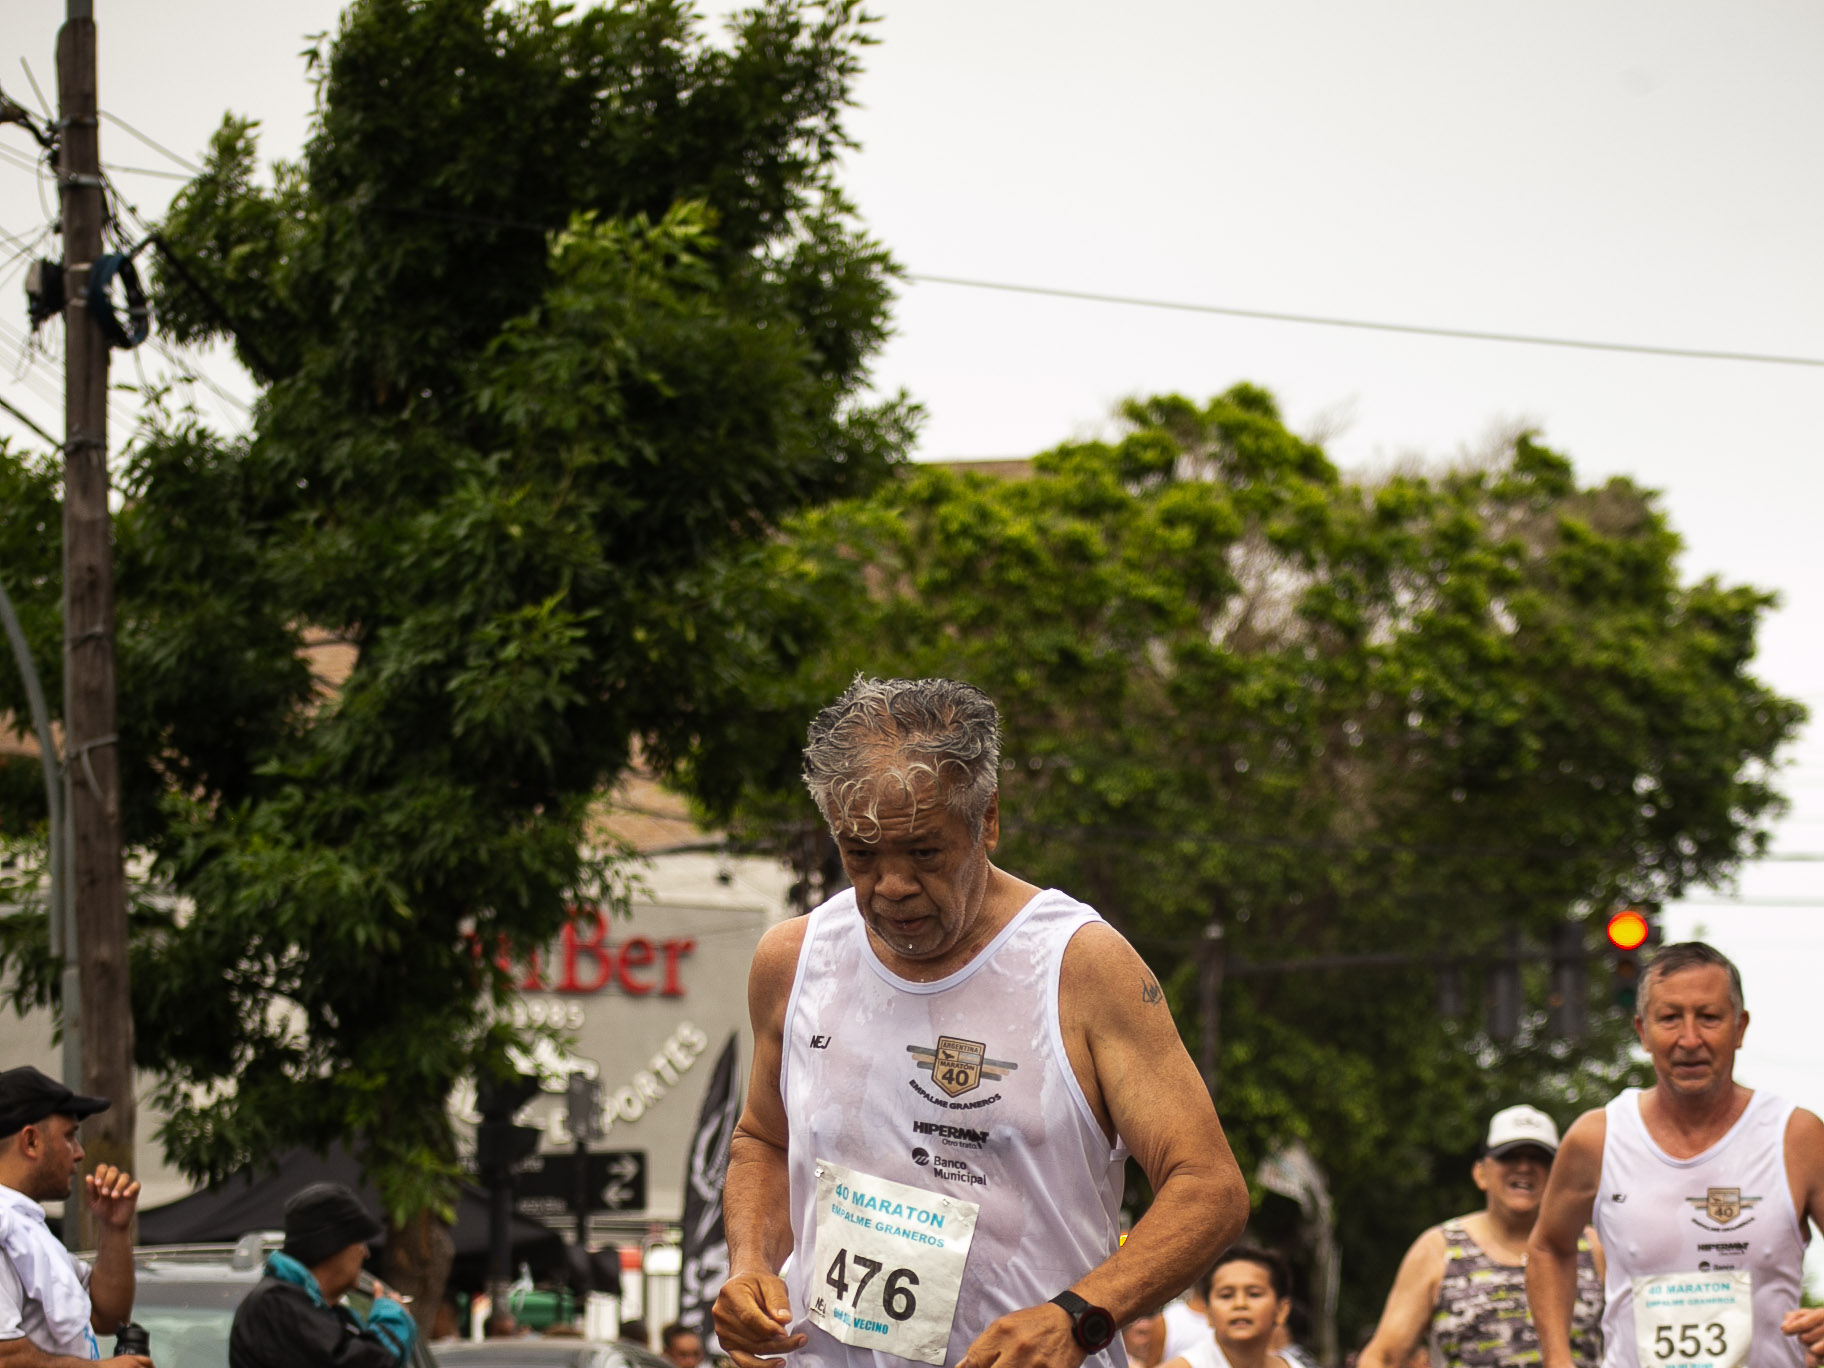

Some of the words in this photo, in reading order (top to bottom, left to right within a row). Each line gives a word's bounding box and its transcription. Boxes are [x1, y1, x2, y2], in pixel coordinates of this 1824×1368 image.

[810, 1035, 832, 1049] NEJ
[942, 1041, 979, 1053] ARGENTINA
[941, 1068, 969, 1087] 40
[909, 1079, 948, 1108] EMPALME
[949, 1093, 1002, 1110] GRANEROS
[942, 1138, 958, 1147] Otro
[933, 1156, 967, 1170] Banco
[933, 1168, 987, 1186] Municipal
[835, 1183, 849, 1201] 40
[851, 1191, 946, 1229] MARATON
[1715, 1206, 1734, 1219] 40
[831, 1203, 872, 1229] EMPALME
[875, 1221, 945, 1248] GRANEROS
[826, 1247, 920, 1322] 476
[1667, 1282, 1731, 1295] MARATON
[853, 1317, 889, 1335] VECINO
[1654, 1322, 1728, 1360] 553
